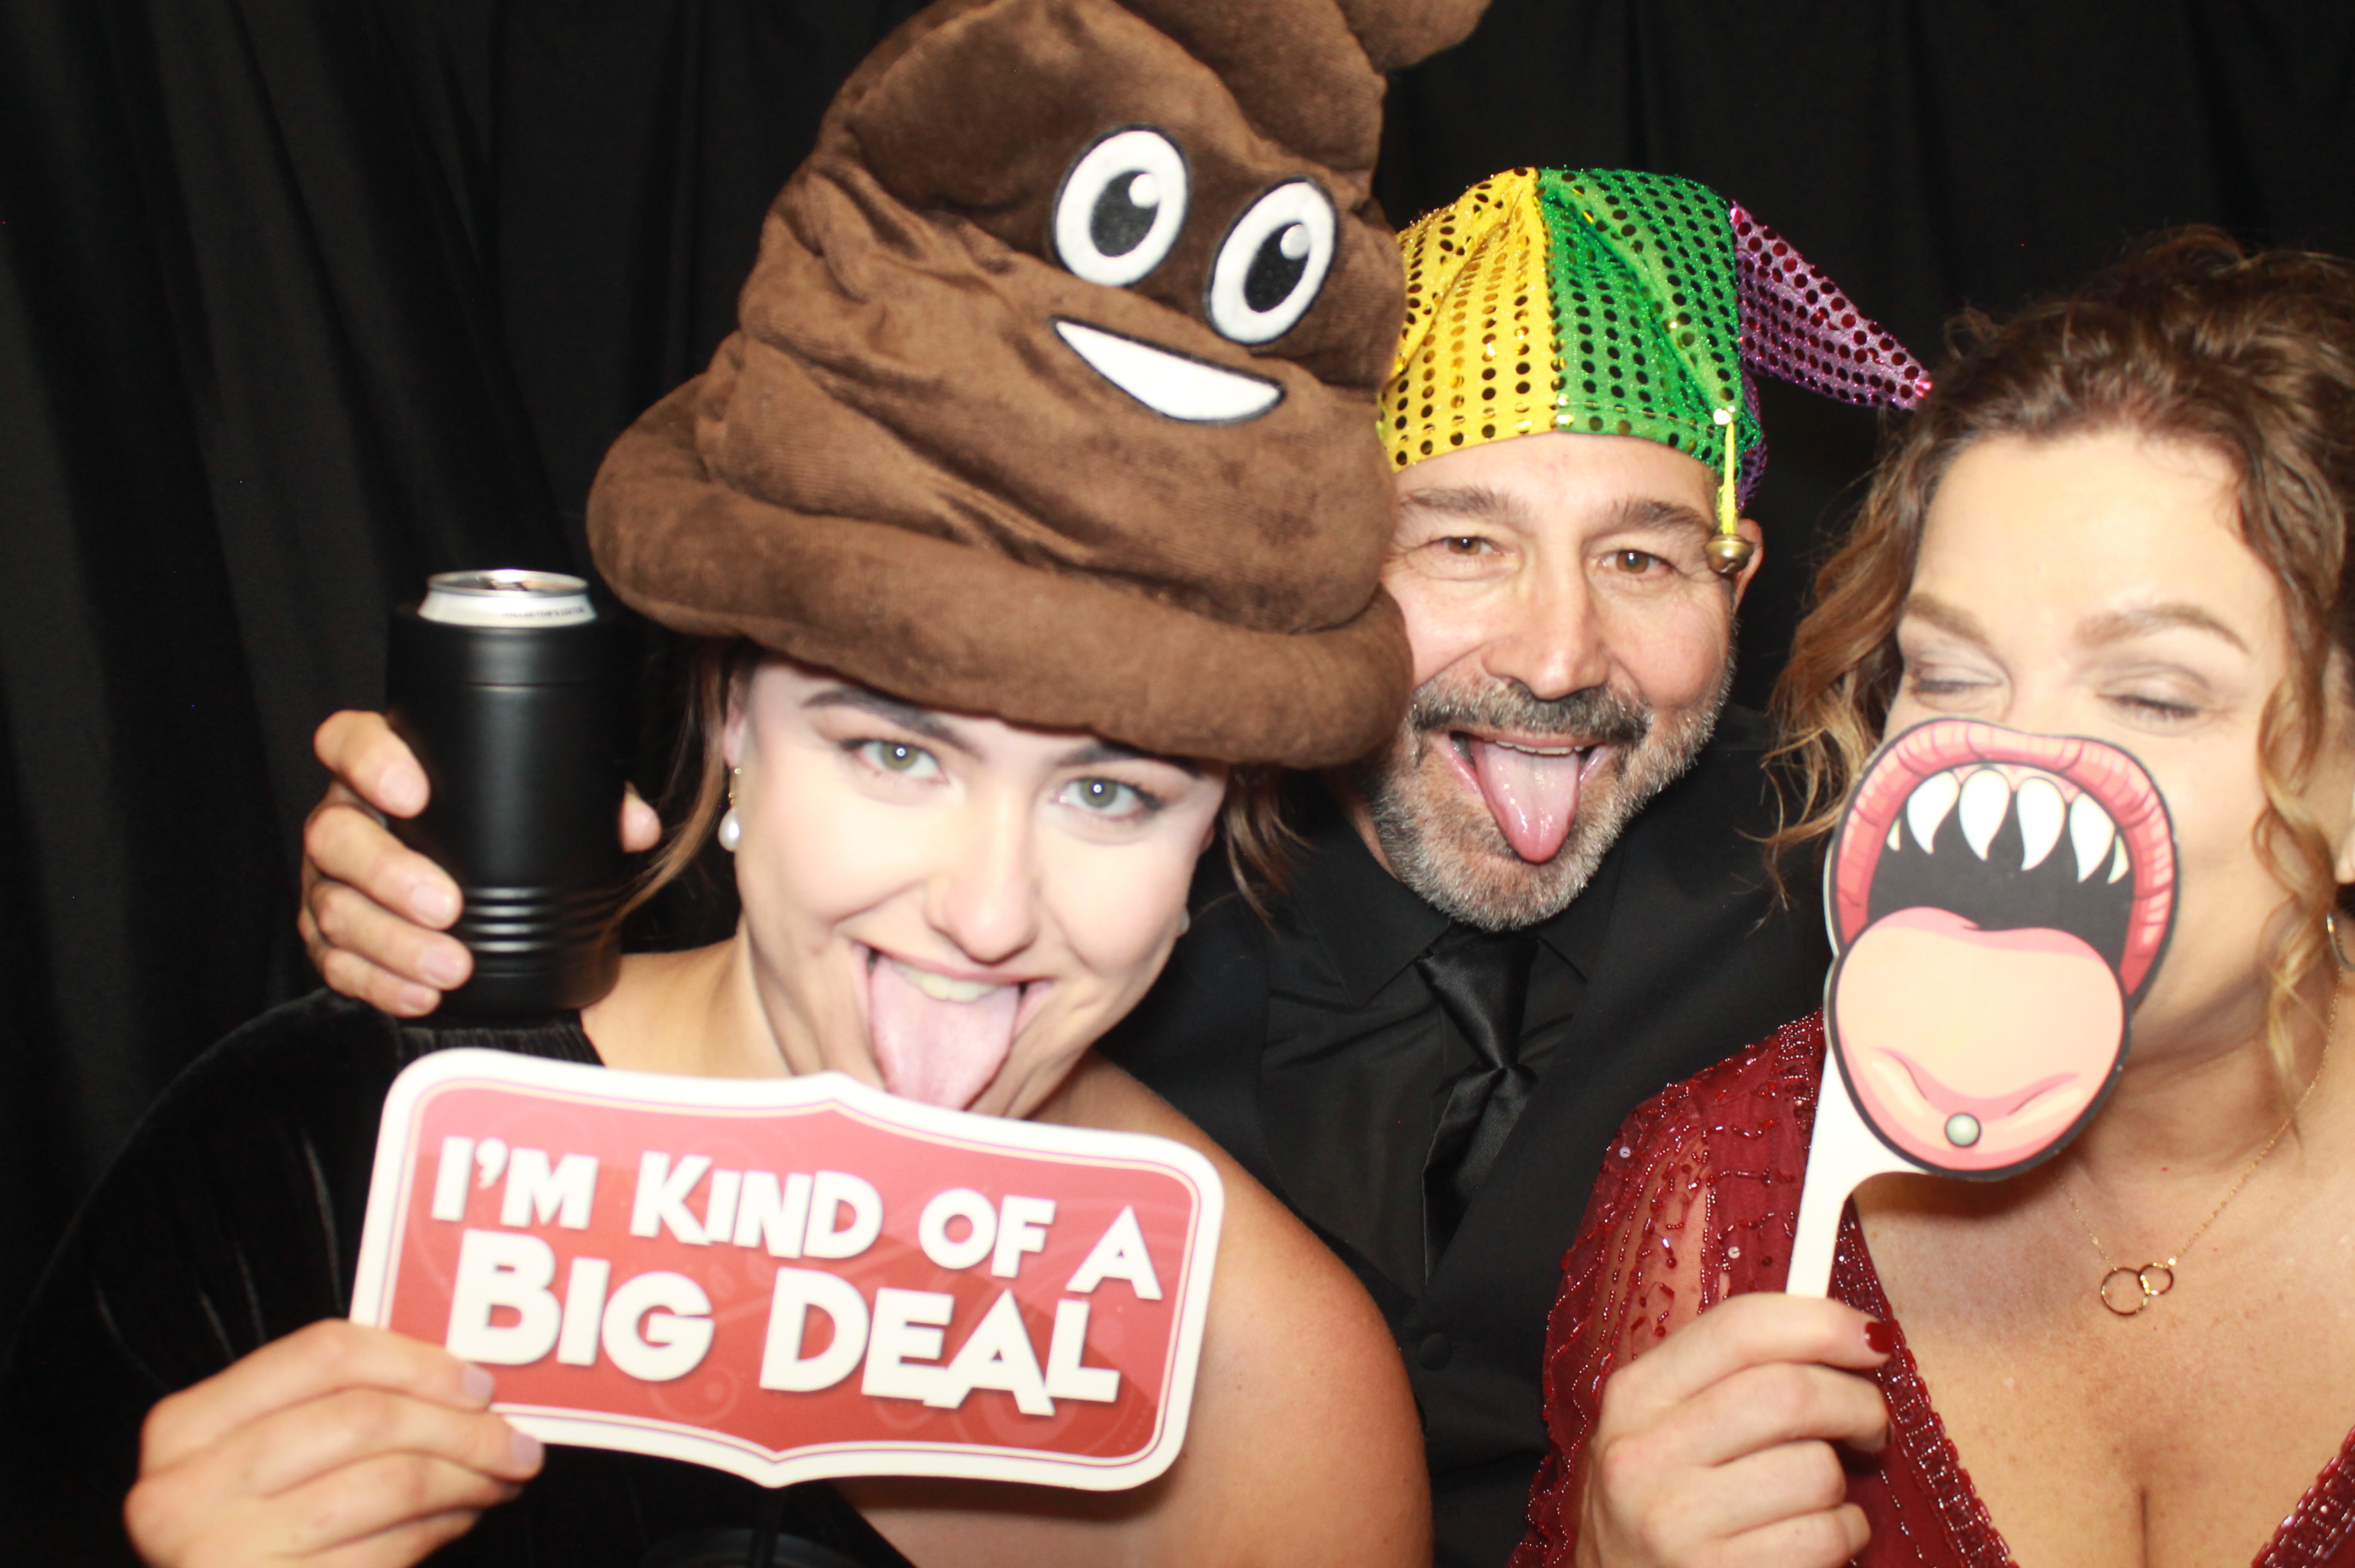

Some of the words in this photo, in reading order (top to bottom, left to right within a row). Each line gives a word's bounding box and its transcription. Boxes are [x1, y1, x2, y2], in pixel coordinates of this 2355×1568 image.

[431, 1135, 599, 1230] I'M
[630, 1150, 883, 1259] KIND
[917, 1187, 1056, 1278] OF
[1065, 1205, 1162, 1300] A
[445, 1229, 714, 1381] BIG
[760, 1267, 1120, 1415] DEAL
